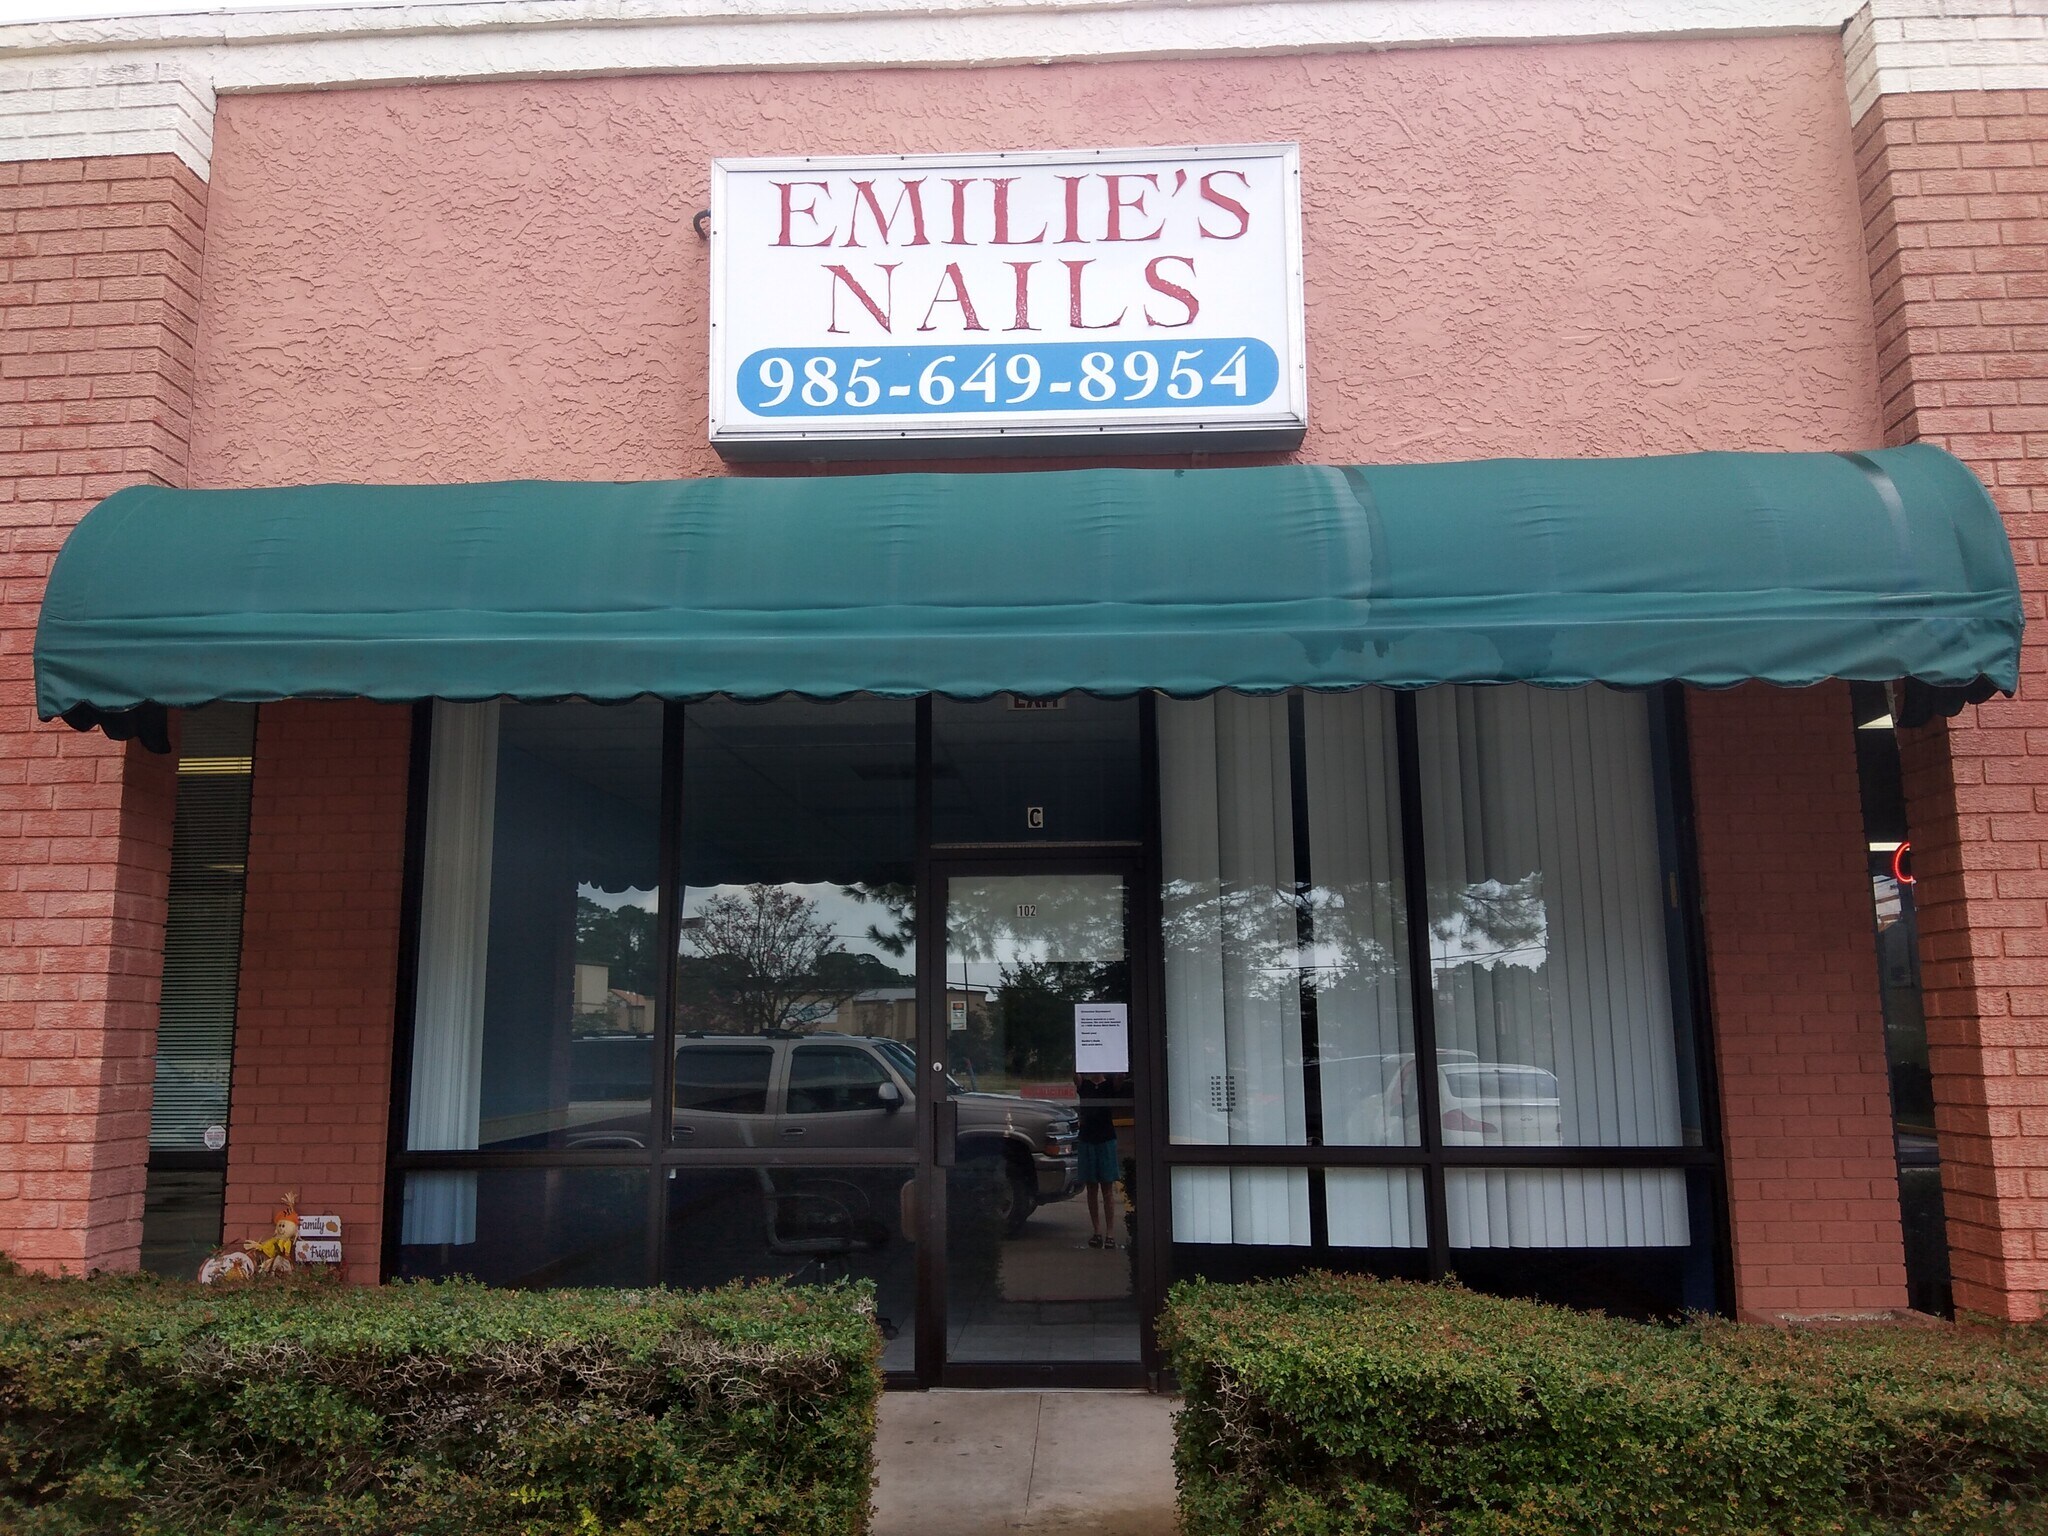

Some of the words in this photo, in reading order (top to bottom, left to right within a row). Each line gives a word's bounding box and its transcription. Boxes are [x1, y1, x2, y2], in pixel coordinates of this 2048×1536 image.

[768, 168, 1250, 248] EMILIE'S
[821, 256, 1200, 335] NAILS
[758, 346, 1248, 408] 985-649-8954
[1030, 808, 1041, 827] C
[1018, 905, 1036, 917] 102
[298, 1217, 324, 1235] Family
[310, 1244, 339, 1259] Friends
